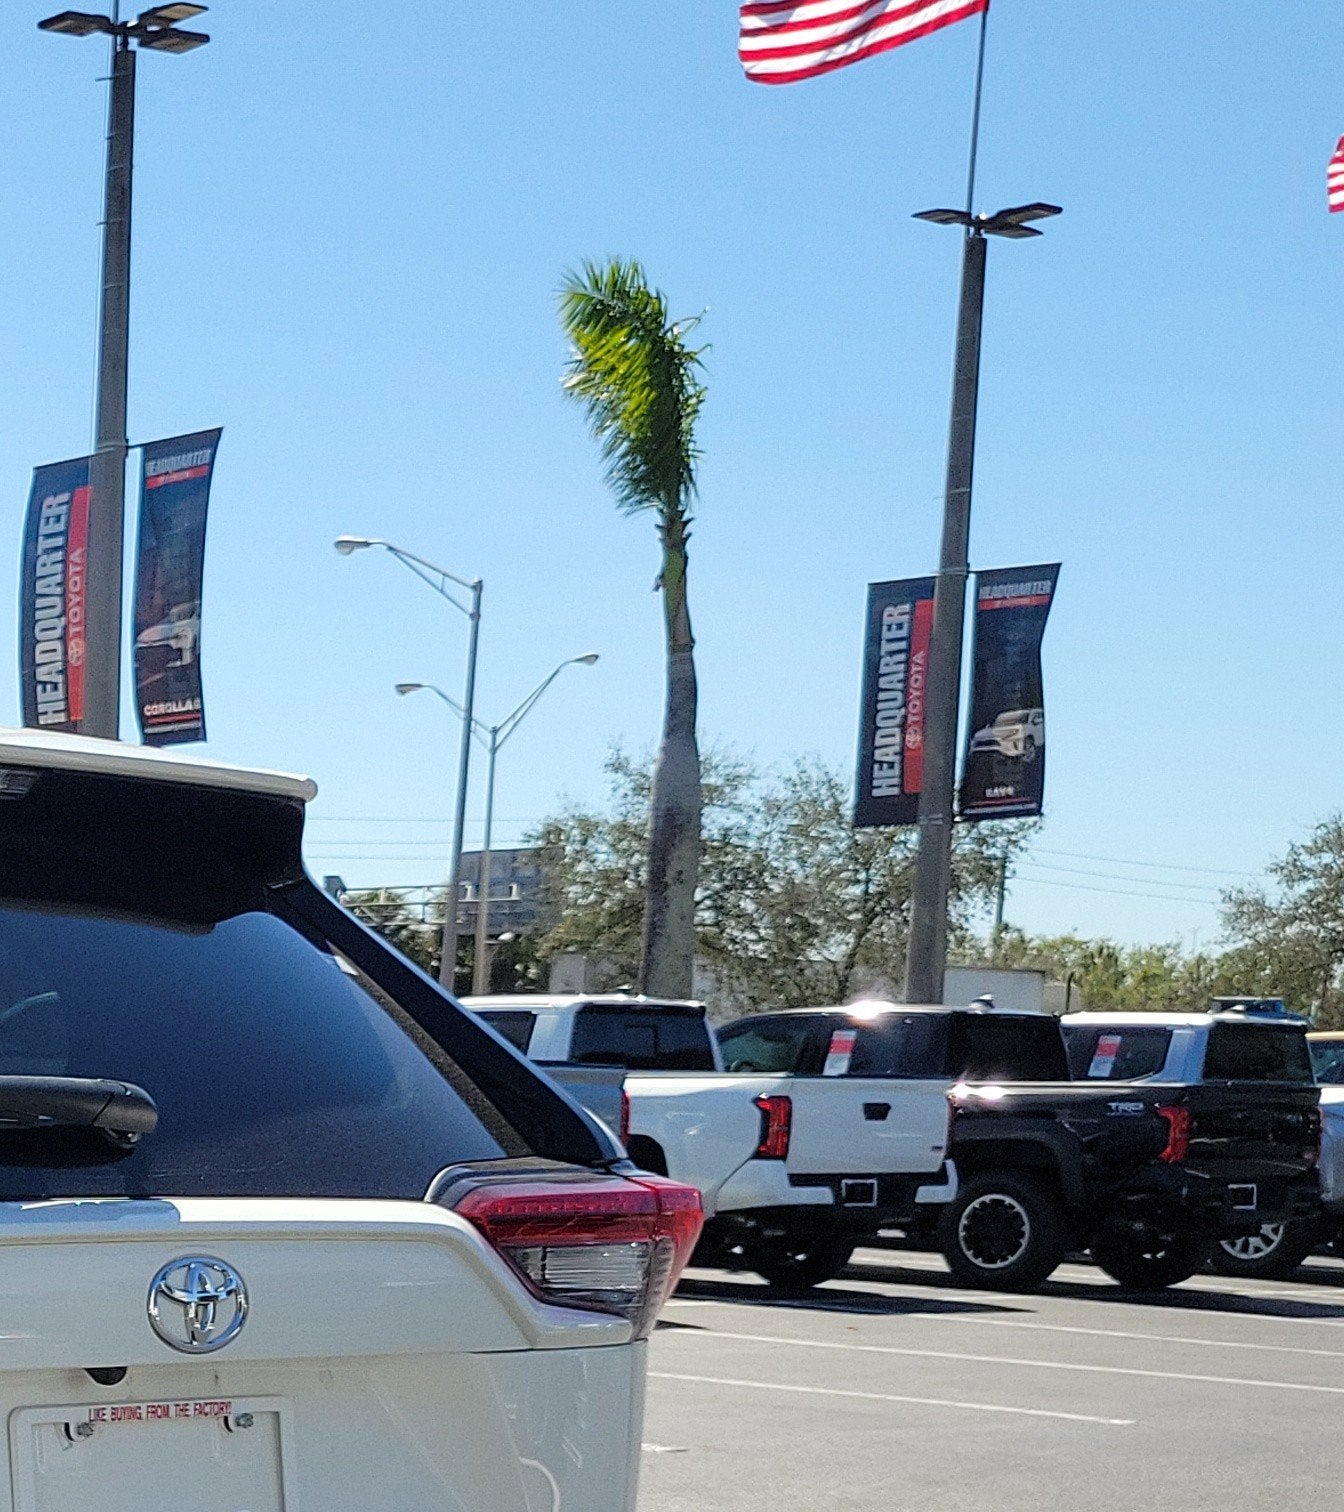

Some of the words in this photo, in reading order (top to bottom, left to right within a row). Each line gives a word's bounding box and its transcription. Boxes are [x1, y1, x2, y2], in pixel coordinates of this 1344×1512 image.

[35, 492, 70, 725] HEADQUARTER
[67, 547, 87, 636] TOYOTA
[871, 602, 911, 798] HEADQUARTER
[907, 651, 927, 724] TOYOTA
[89, 1408, 107, 1422] LIKE
[111, 1405, 142, 1421] BUYING
[146, 1404, 171, 1420] FROM
[174, 1403, 190, 1418] THE
